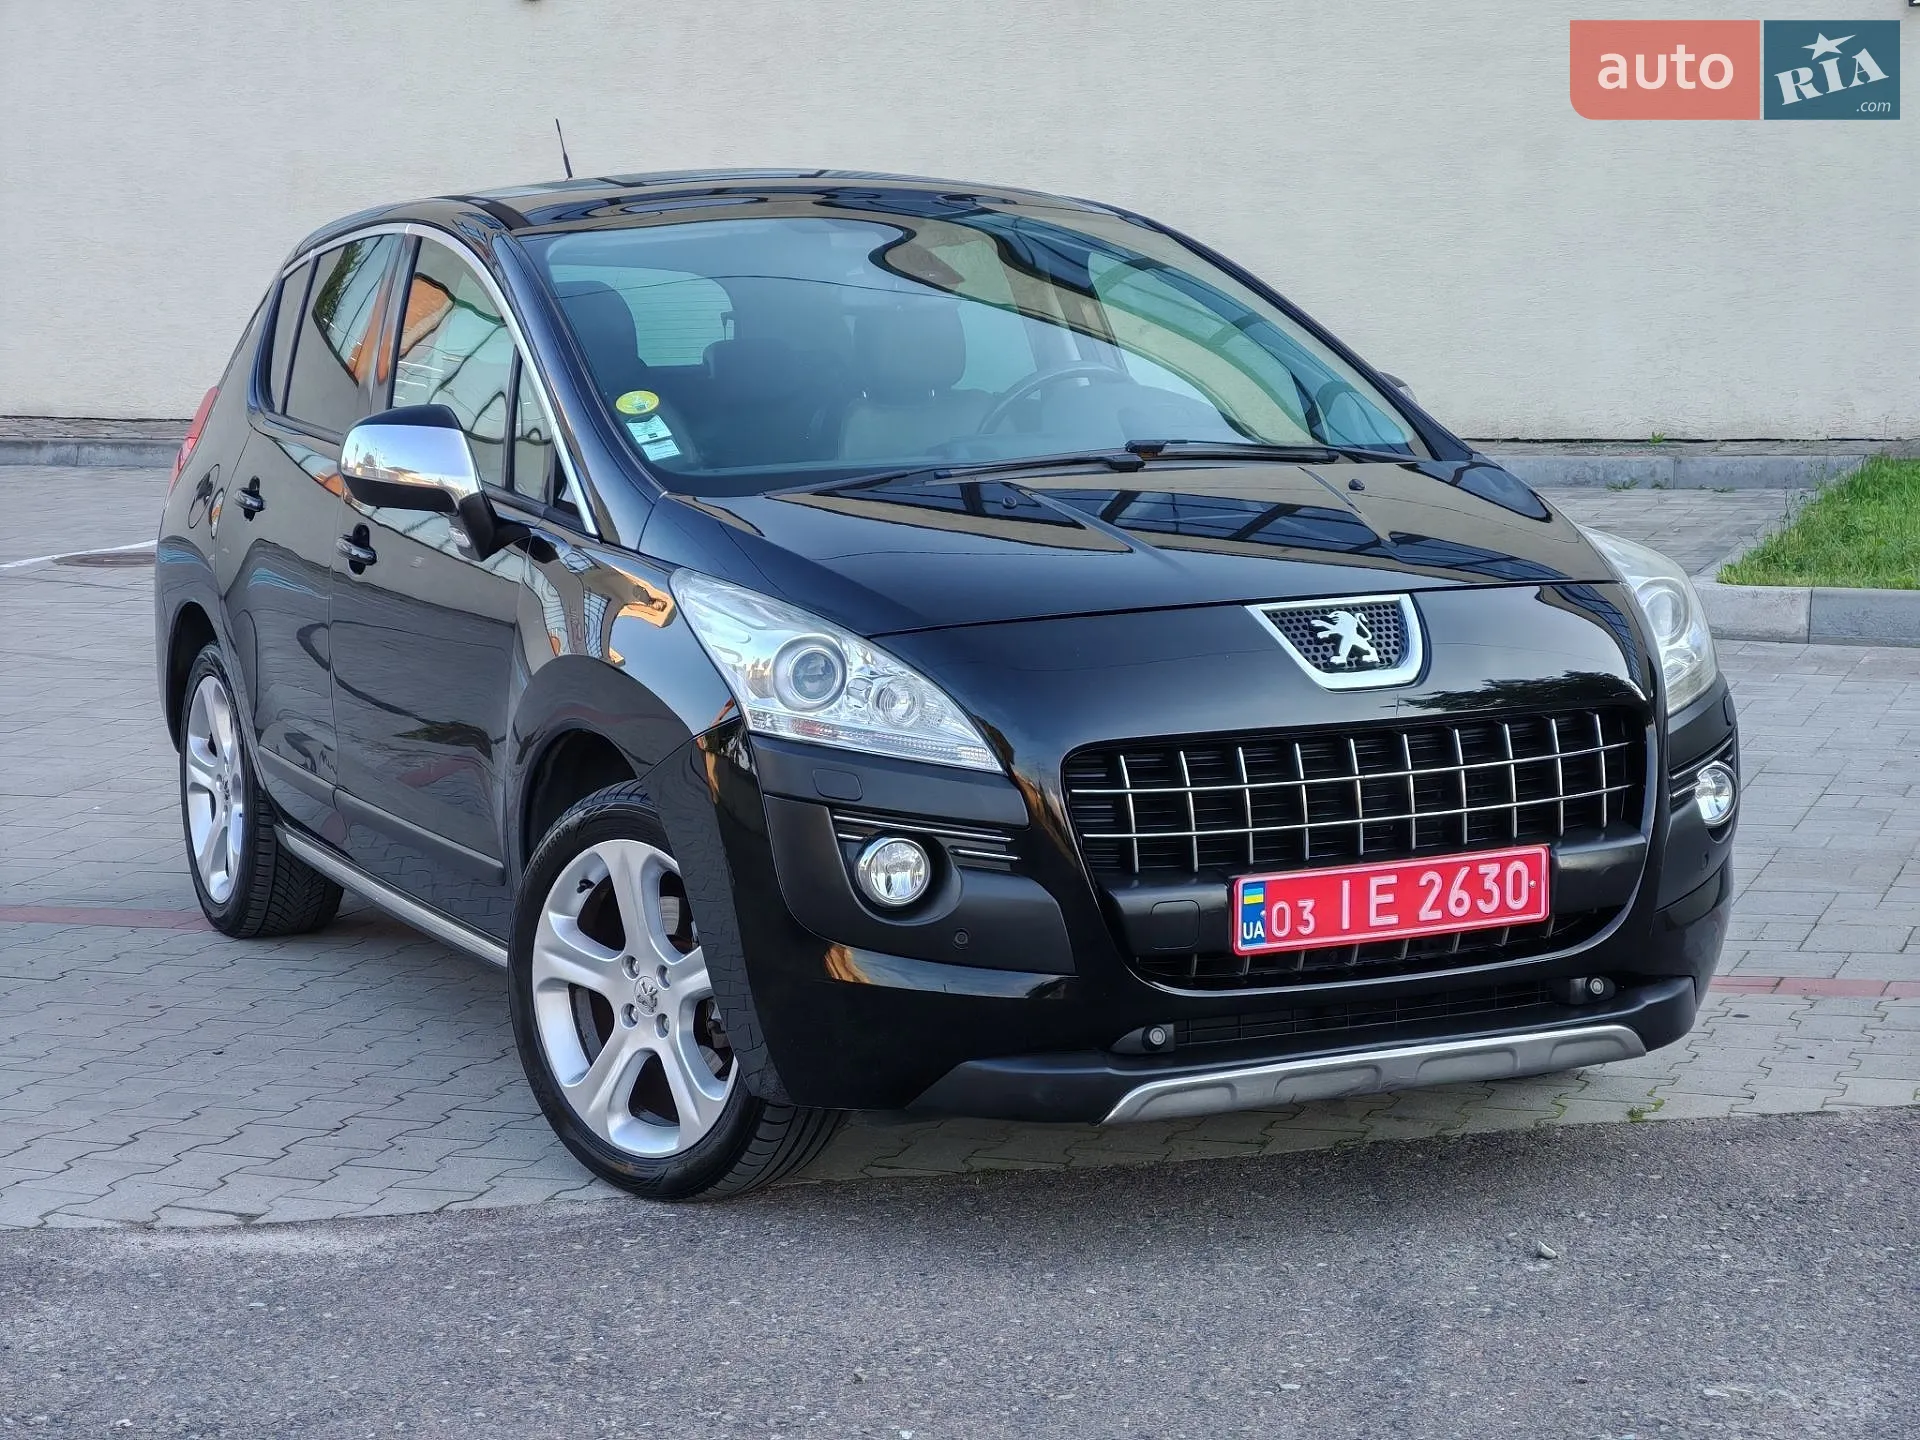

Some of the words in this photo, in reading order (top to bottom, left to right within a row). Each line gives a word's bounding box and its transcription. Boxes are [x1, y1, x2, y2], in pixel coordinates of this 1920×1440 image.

[1271, 899, 1316, 938] 03
[1341, 874, 1399, 931] IE
[1418, 859, 1529, 922] 2630
[1242, 921, 1265, 940] UA
